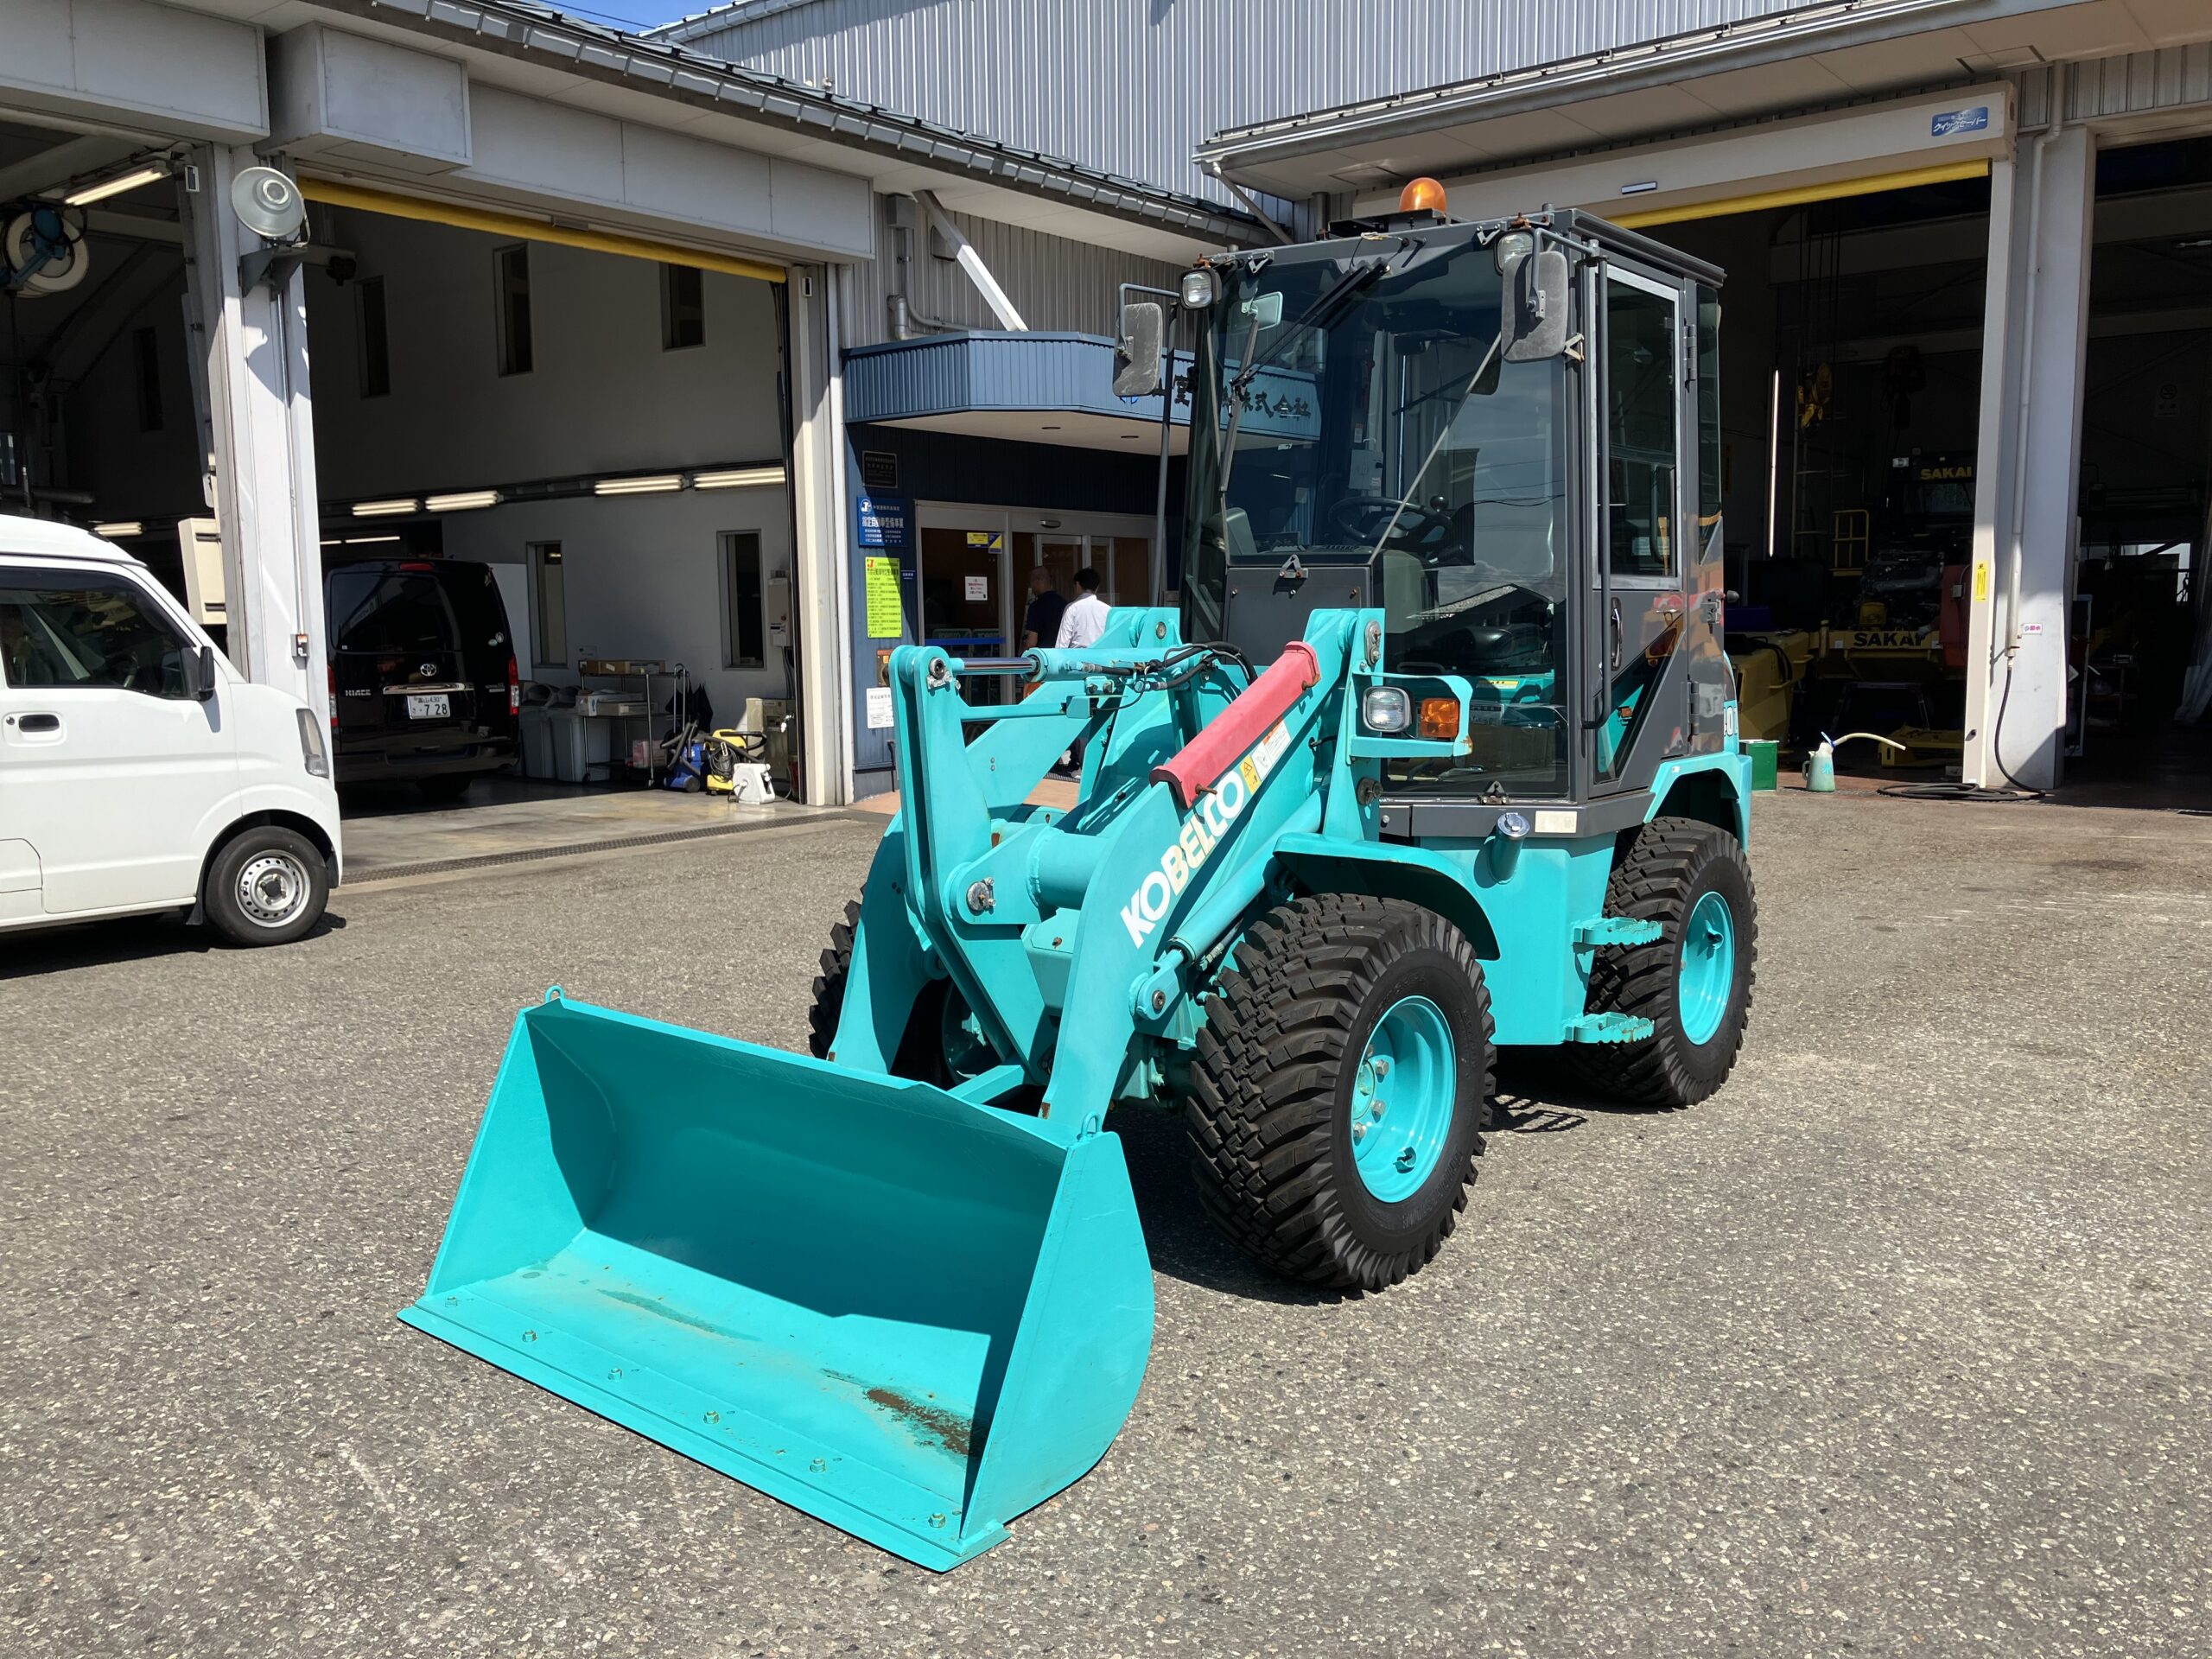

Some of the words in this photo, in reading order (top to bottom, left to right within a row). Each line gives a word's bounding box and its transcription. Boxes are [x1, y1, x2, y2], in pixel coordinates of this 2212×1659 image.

[1920, 467, 1972, 480] SAKAI
[1853, 632, 1923, 647] SAKAI
[1120, 771, 1244, 950] KOBELCO
